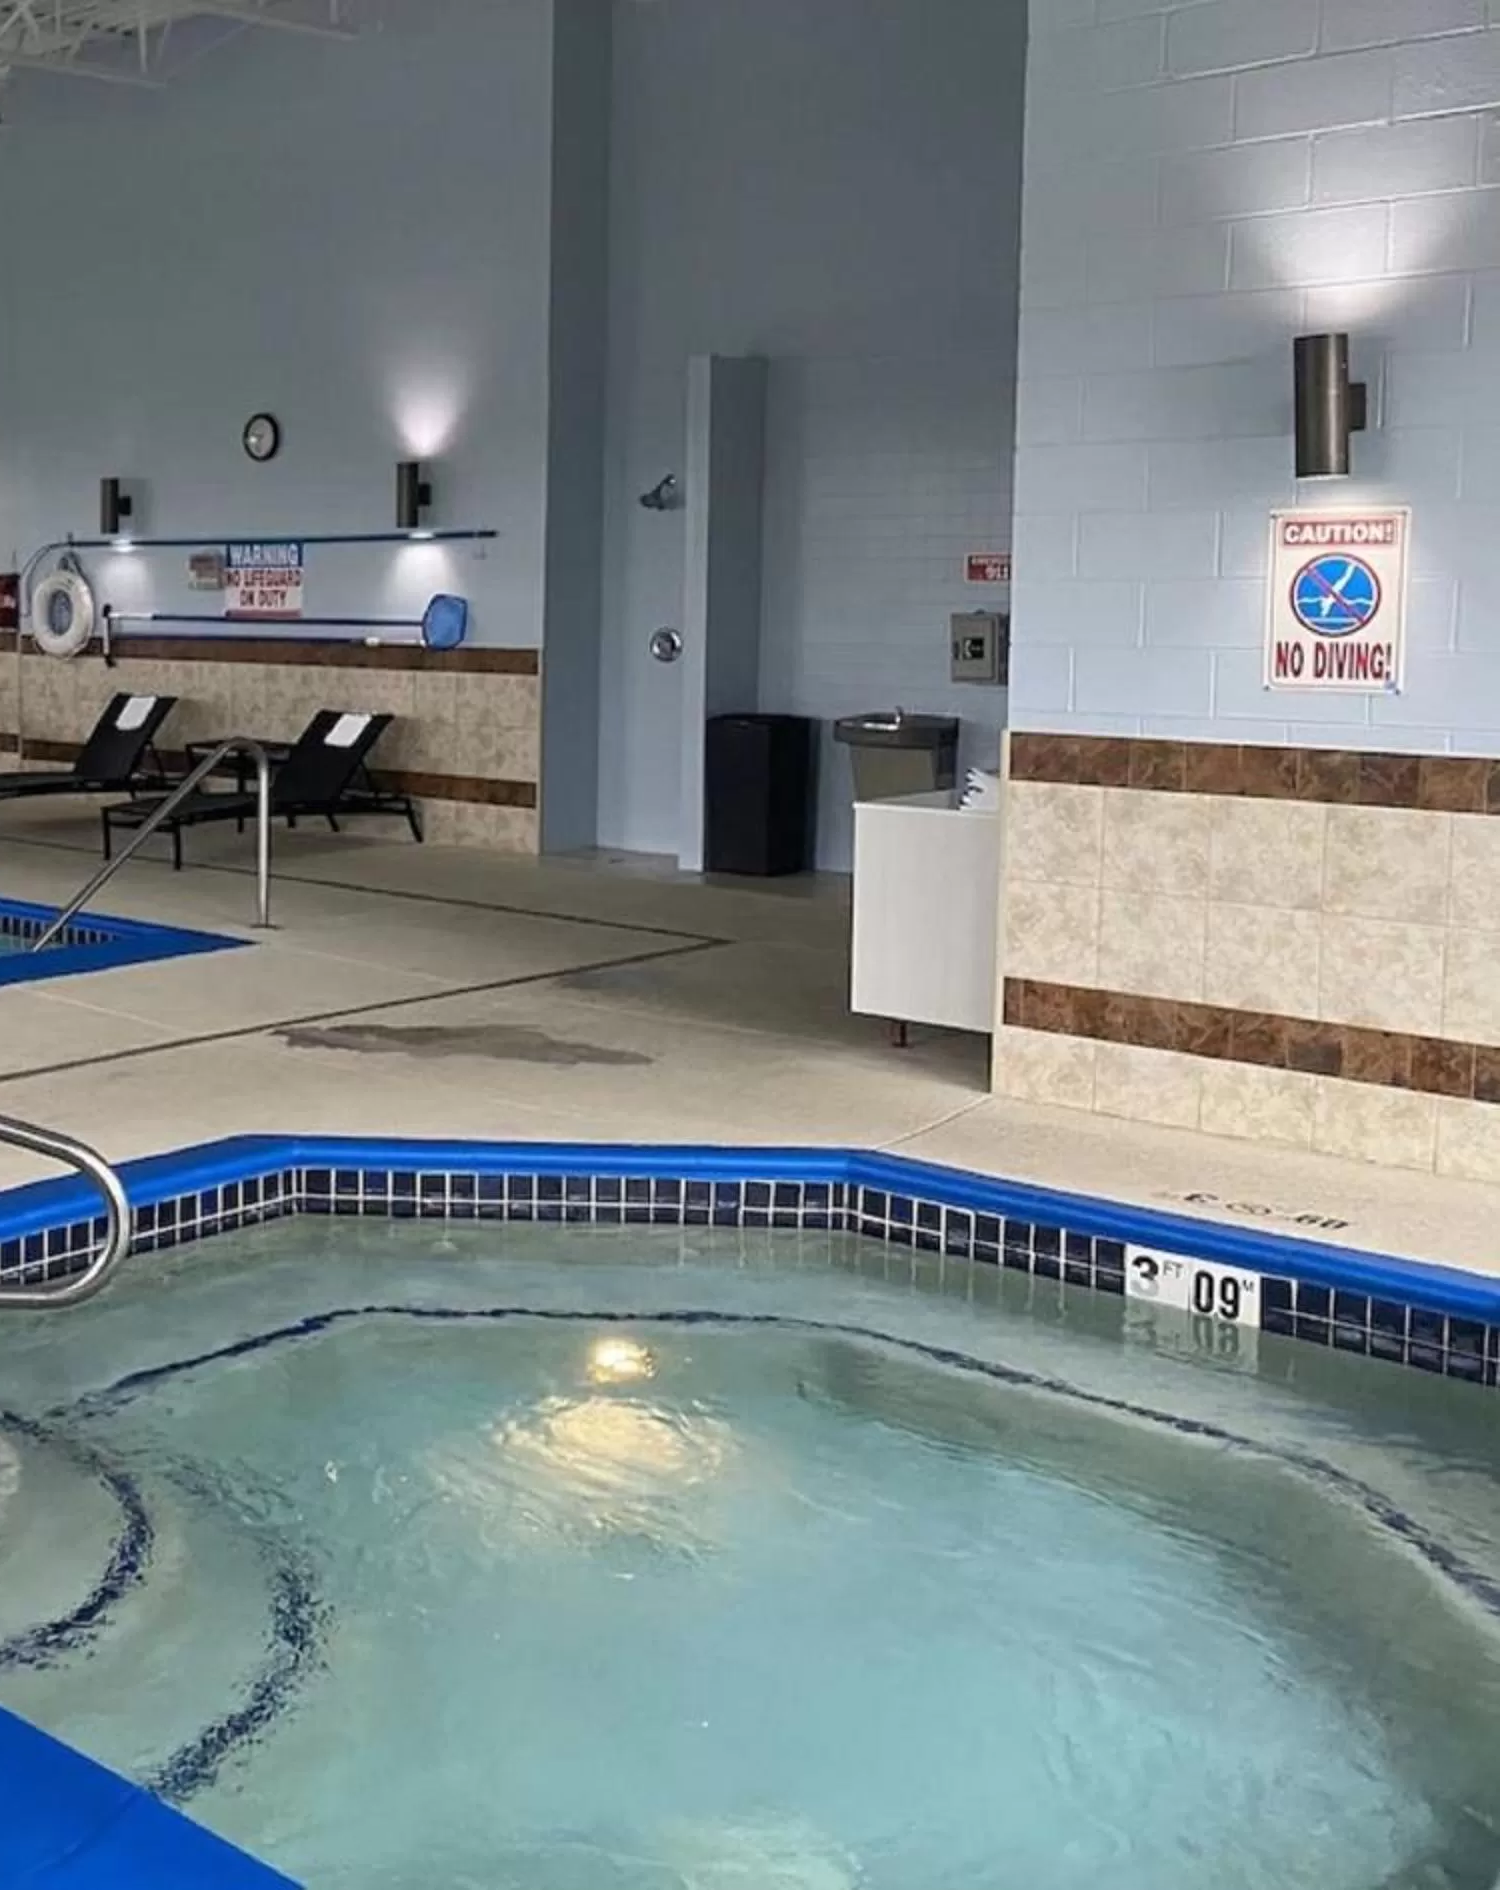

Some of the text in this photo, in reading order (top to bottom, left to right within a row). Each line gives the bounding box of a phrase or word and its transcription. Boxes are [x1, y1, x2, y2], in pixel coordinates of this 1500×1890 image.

[1285, 522, 1394, 544] CAUTION!
[230, 543, 299, 566] WARNING
[1276, 641, 1393, 681] NO DIVING!
[1132, 1255, 1159, 1297] 3
[1163, 1260, 1183, 1279] FT
